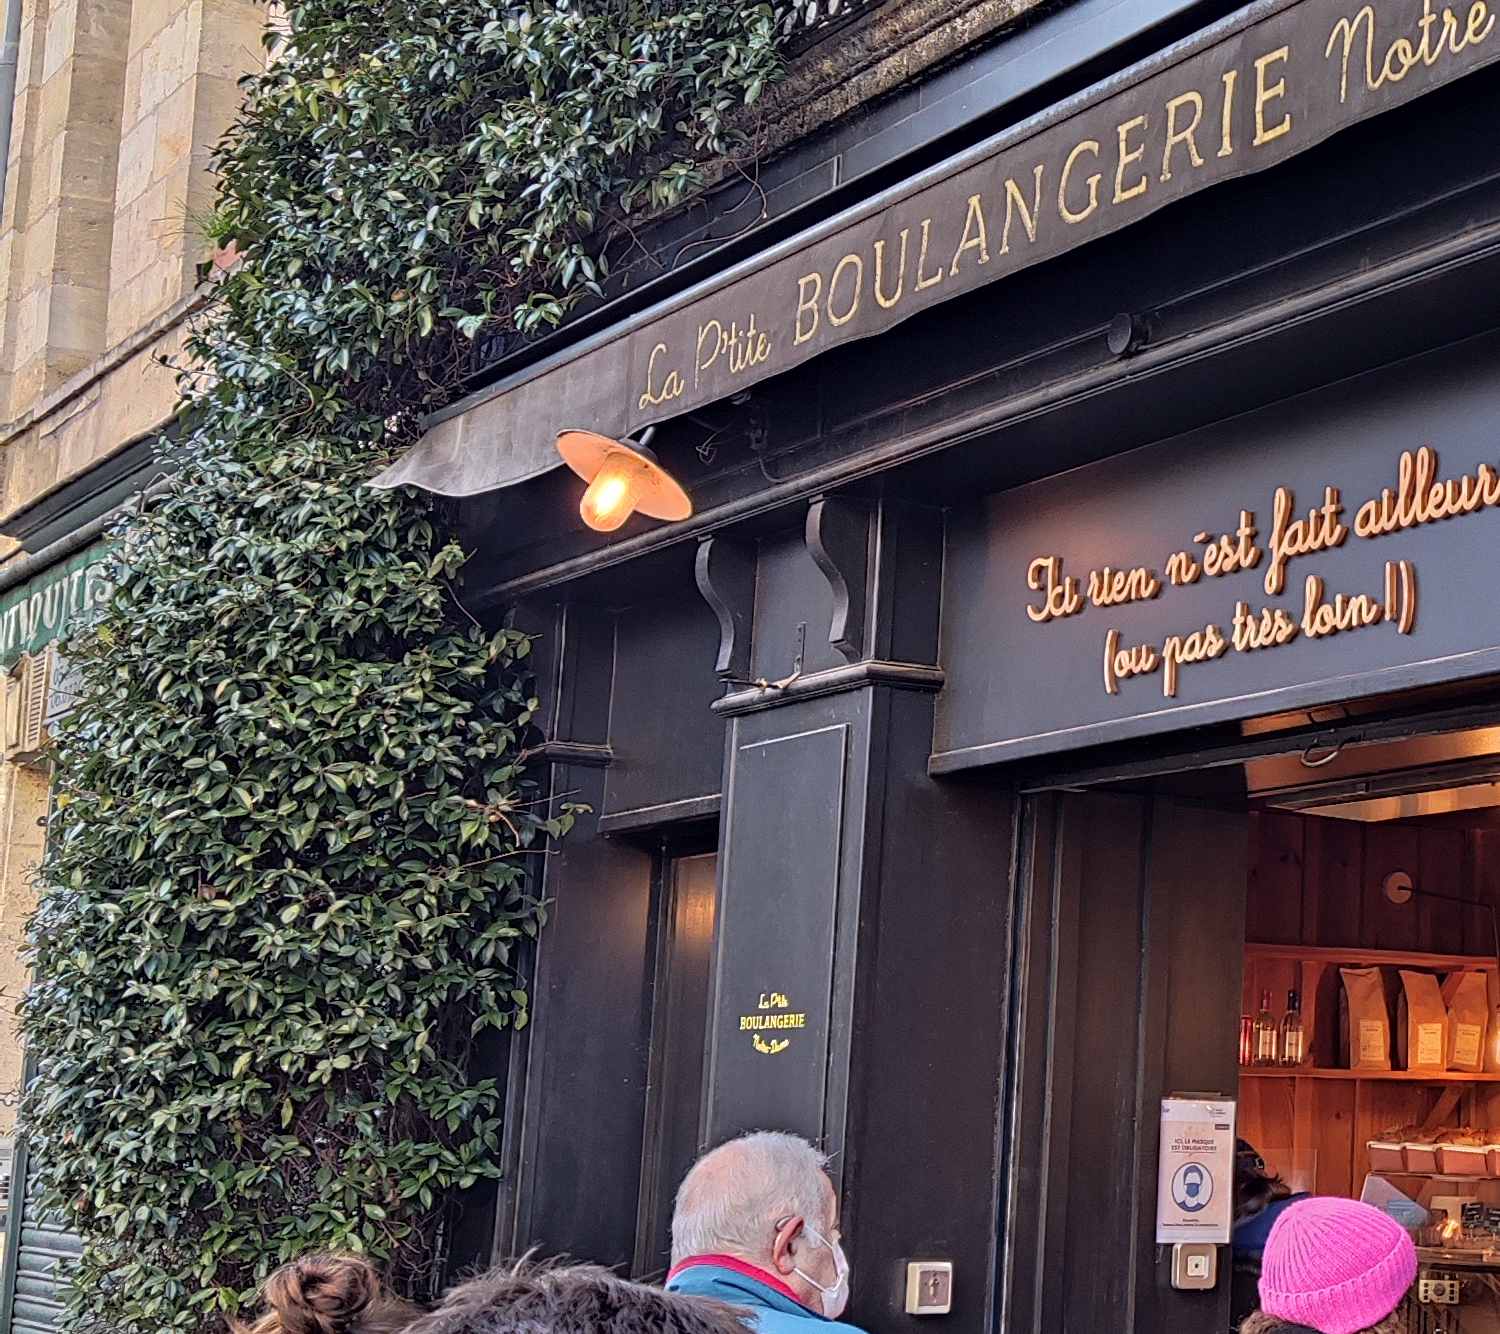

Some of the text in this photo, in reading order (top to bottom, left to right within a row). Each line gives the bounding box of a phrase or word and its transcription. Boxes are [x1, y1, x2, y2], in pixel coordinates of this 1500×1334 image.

[638, 343, 685, 410] La
[694, 313, 772, 390] P'tite
[792, 45, 1293, 347] BOULANGERIE
[1026, 556, 1083, 623] Ici
[1087, 560, 1160, 609] rien
[1165, 508, 1262, 585] n'est
[1263, 485, 1348, 595] fait
[1102, 627, 1160, 696] (ou
[1162, 622, 1230, 698] pas
[1232, 600, 1298, 655] très
[1300, 573, 1382, 639] loin
[740, 1013, 805, 1030] BOULANGERIE
